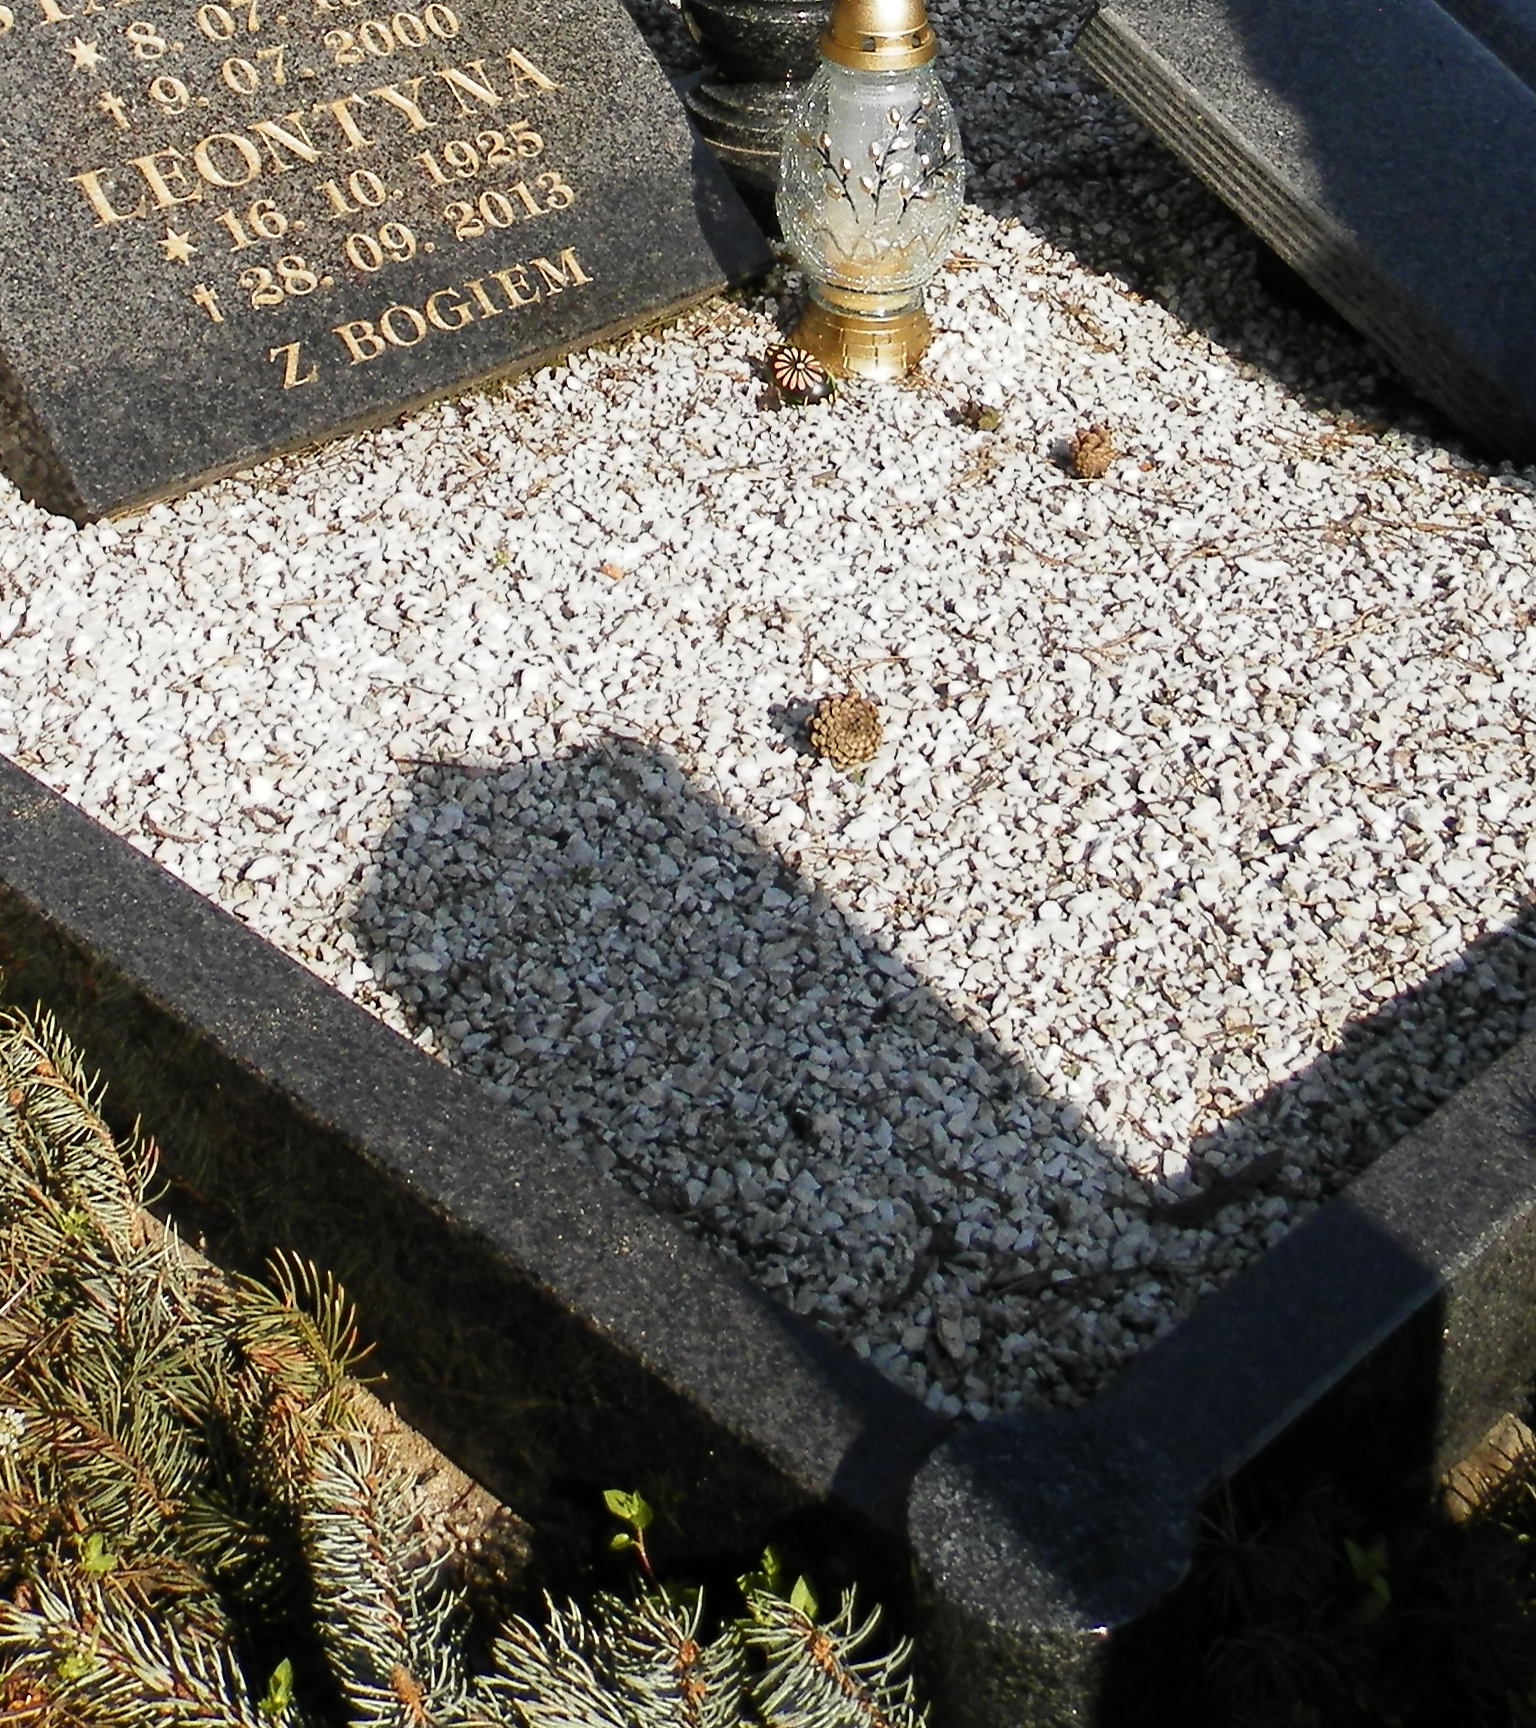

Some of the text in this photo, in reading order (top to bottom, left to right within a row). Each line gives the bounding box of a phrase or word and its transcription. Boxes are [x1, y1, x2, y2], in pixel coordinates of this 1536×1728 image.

[323, 1, 462, 66] 2000
[67, 46, 565, 229] LEONTYNA
[413, 118, 546, 189] 1925
[442, 170, 577, 243] 2013
[268, 244, 595, 391] Z BOGIEM
